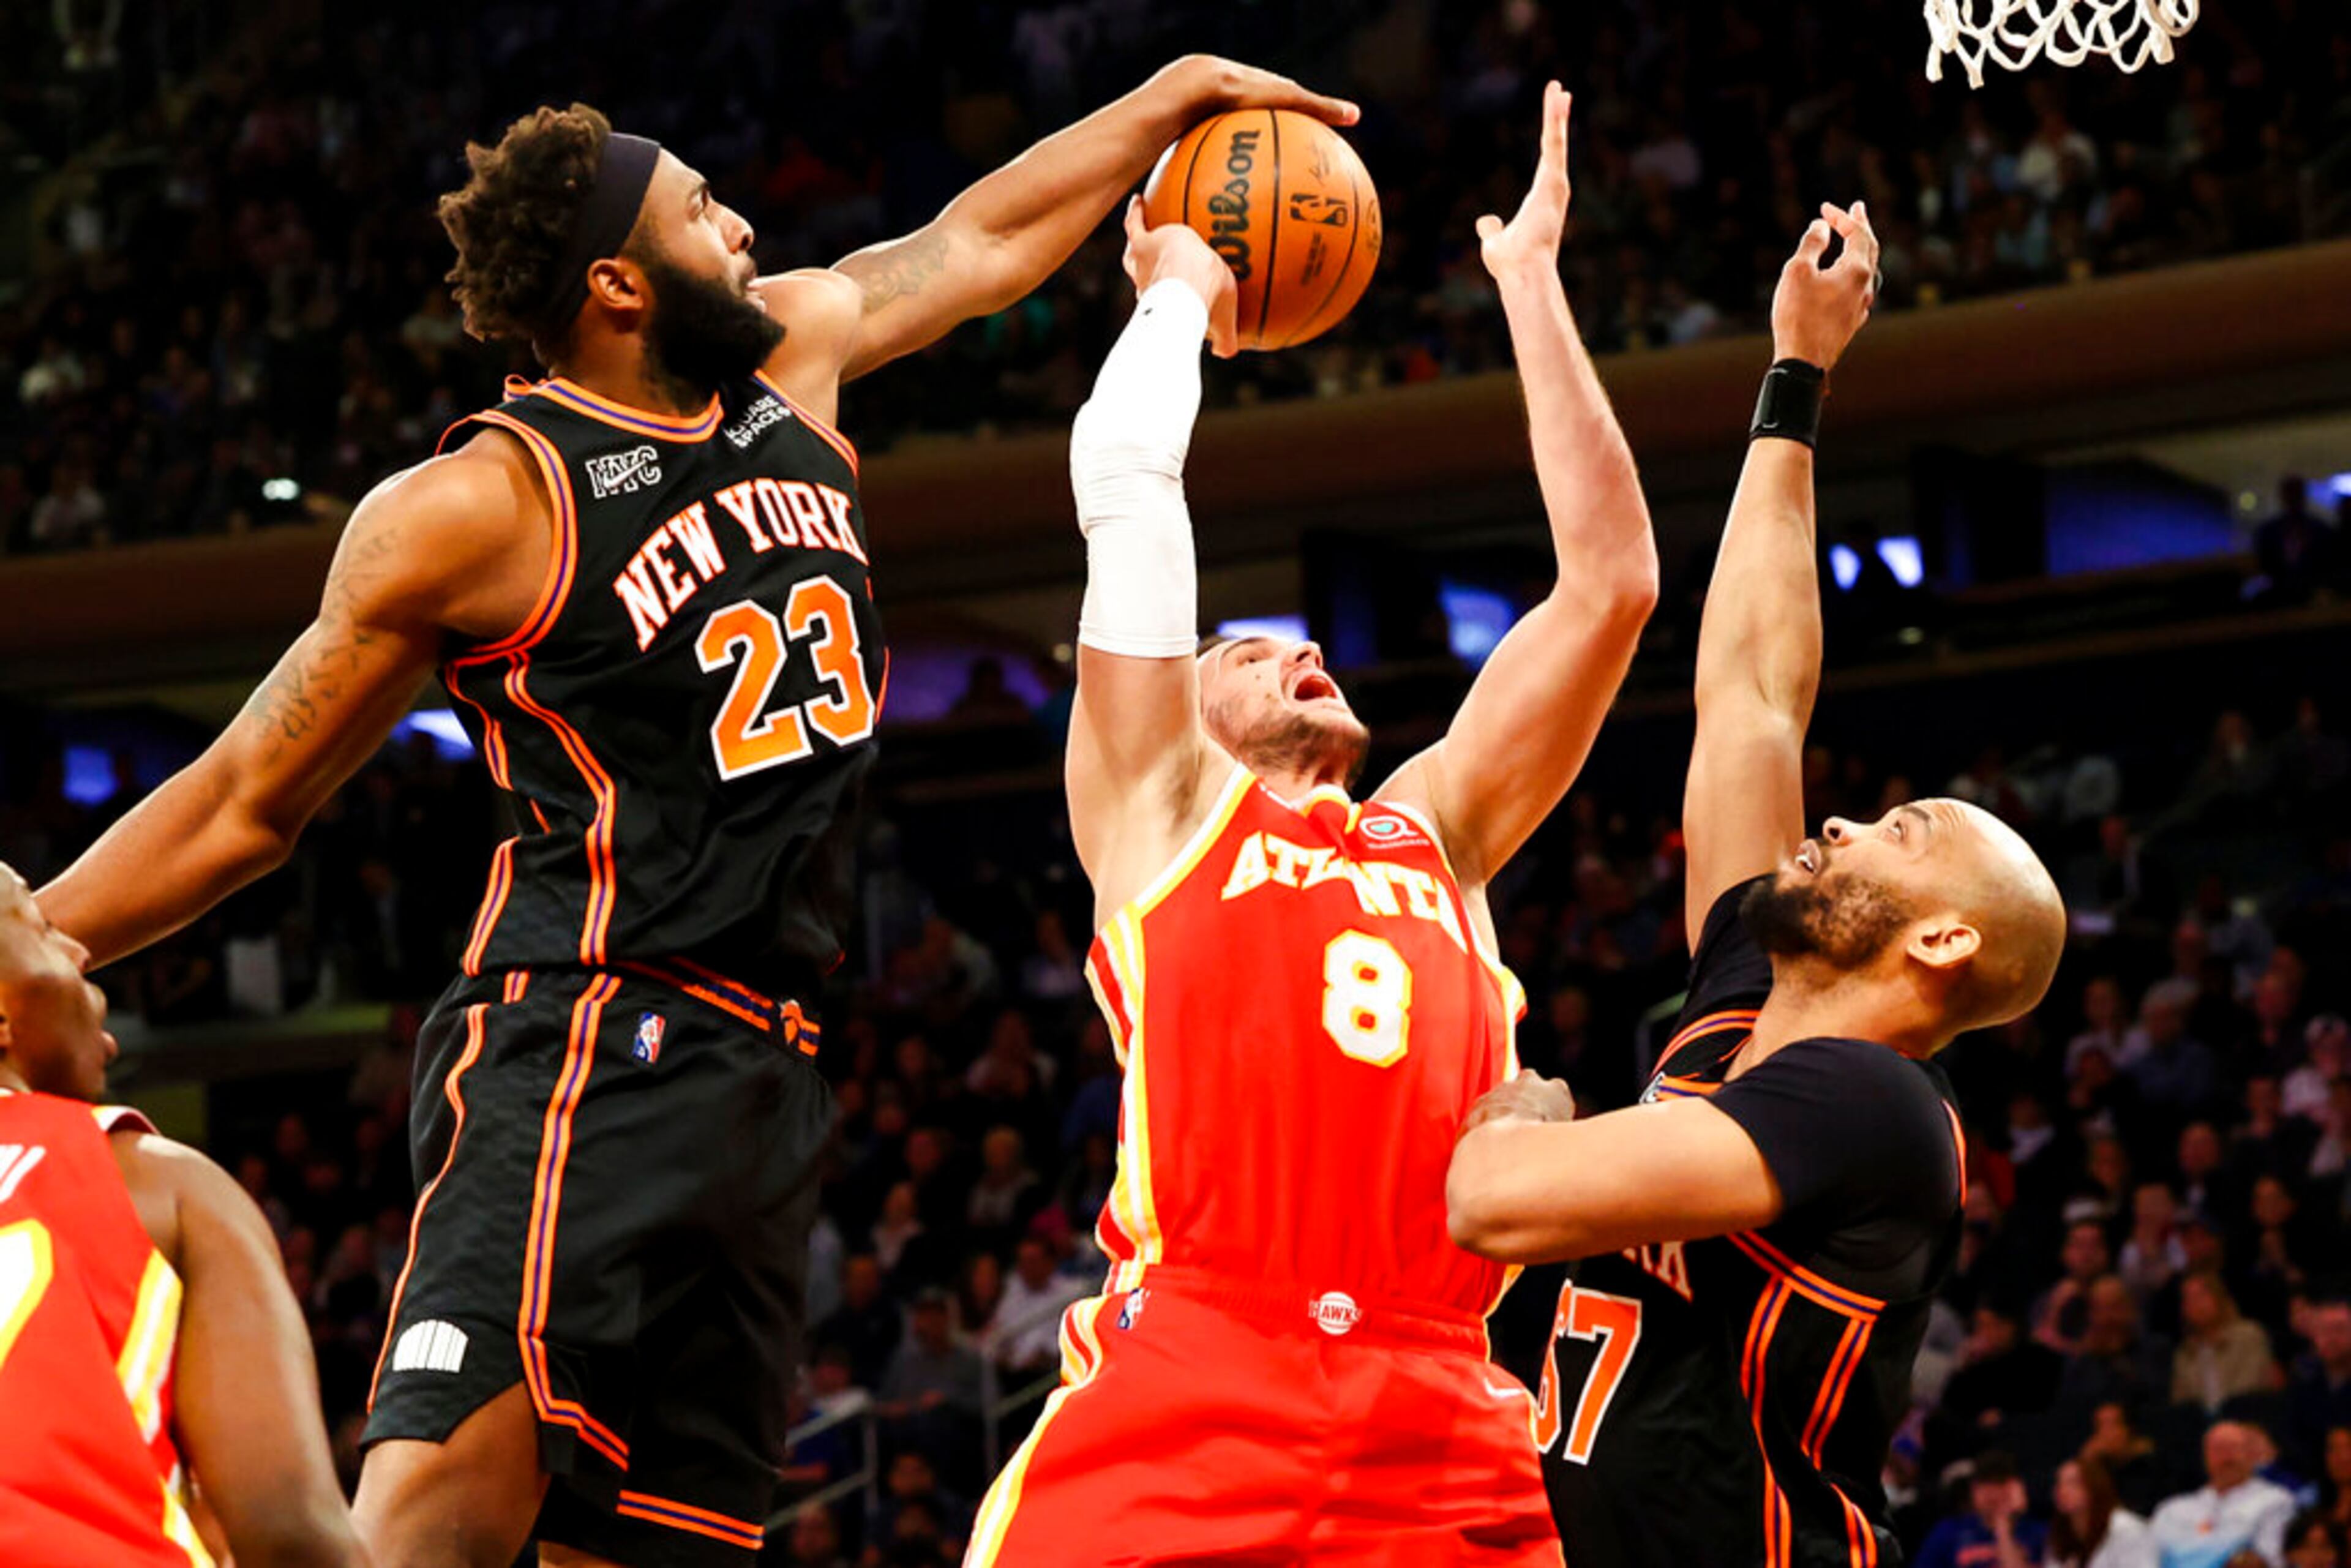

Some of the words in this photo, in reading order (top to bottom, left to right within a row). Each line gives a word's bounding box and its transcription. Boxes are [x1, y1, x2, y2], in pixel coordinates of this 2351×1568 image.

[612, 500, 727, 653] NEW
[713, 477, 870, 566] YORK
[694, 574, 876, 782] 23
[1322, 928, 1412, 1068] 8
